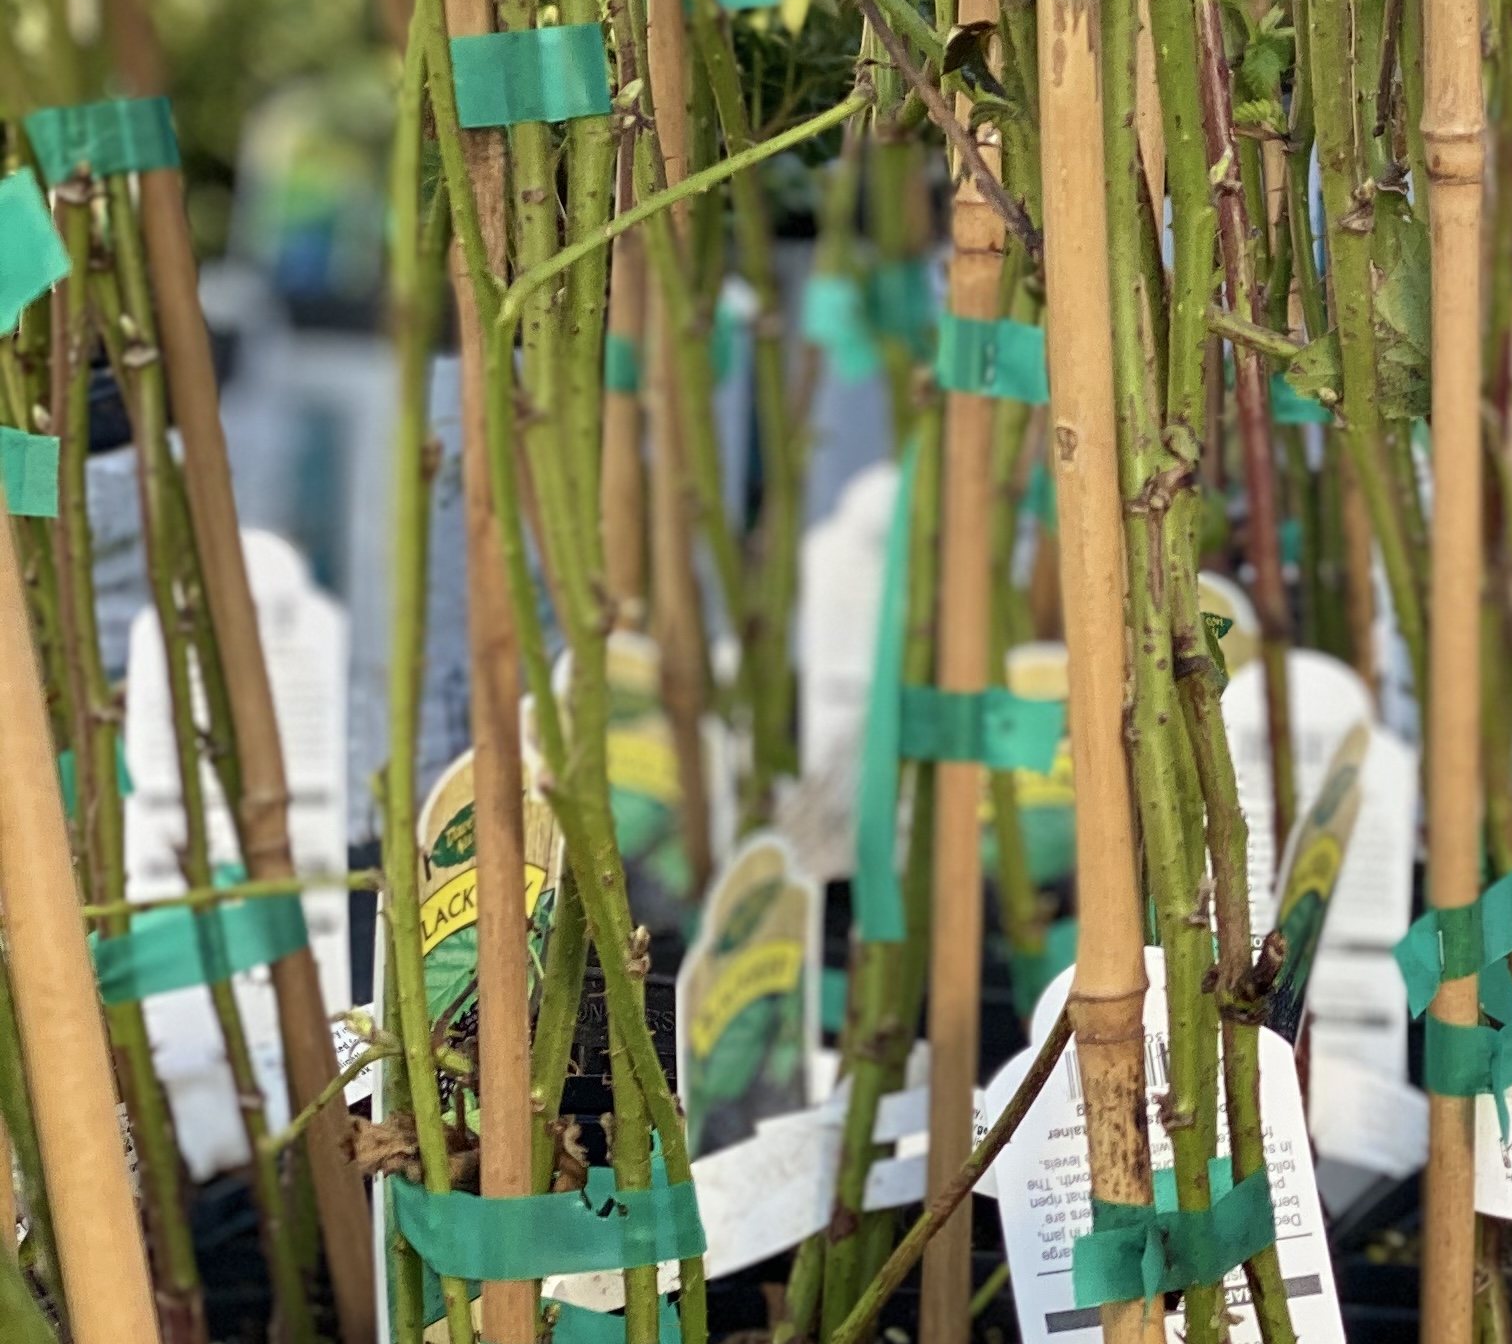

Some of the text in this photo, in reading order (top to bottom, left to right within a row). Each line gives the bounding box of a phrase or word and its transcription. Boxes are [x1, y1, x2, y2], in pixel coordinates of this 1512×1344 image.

[1039, 1154, 1082, 1173] levels.
[1026, 1177, 1053, 1193] The
[1029, 1192, 1062, 1211] ripen
